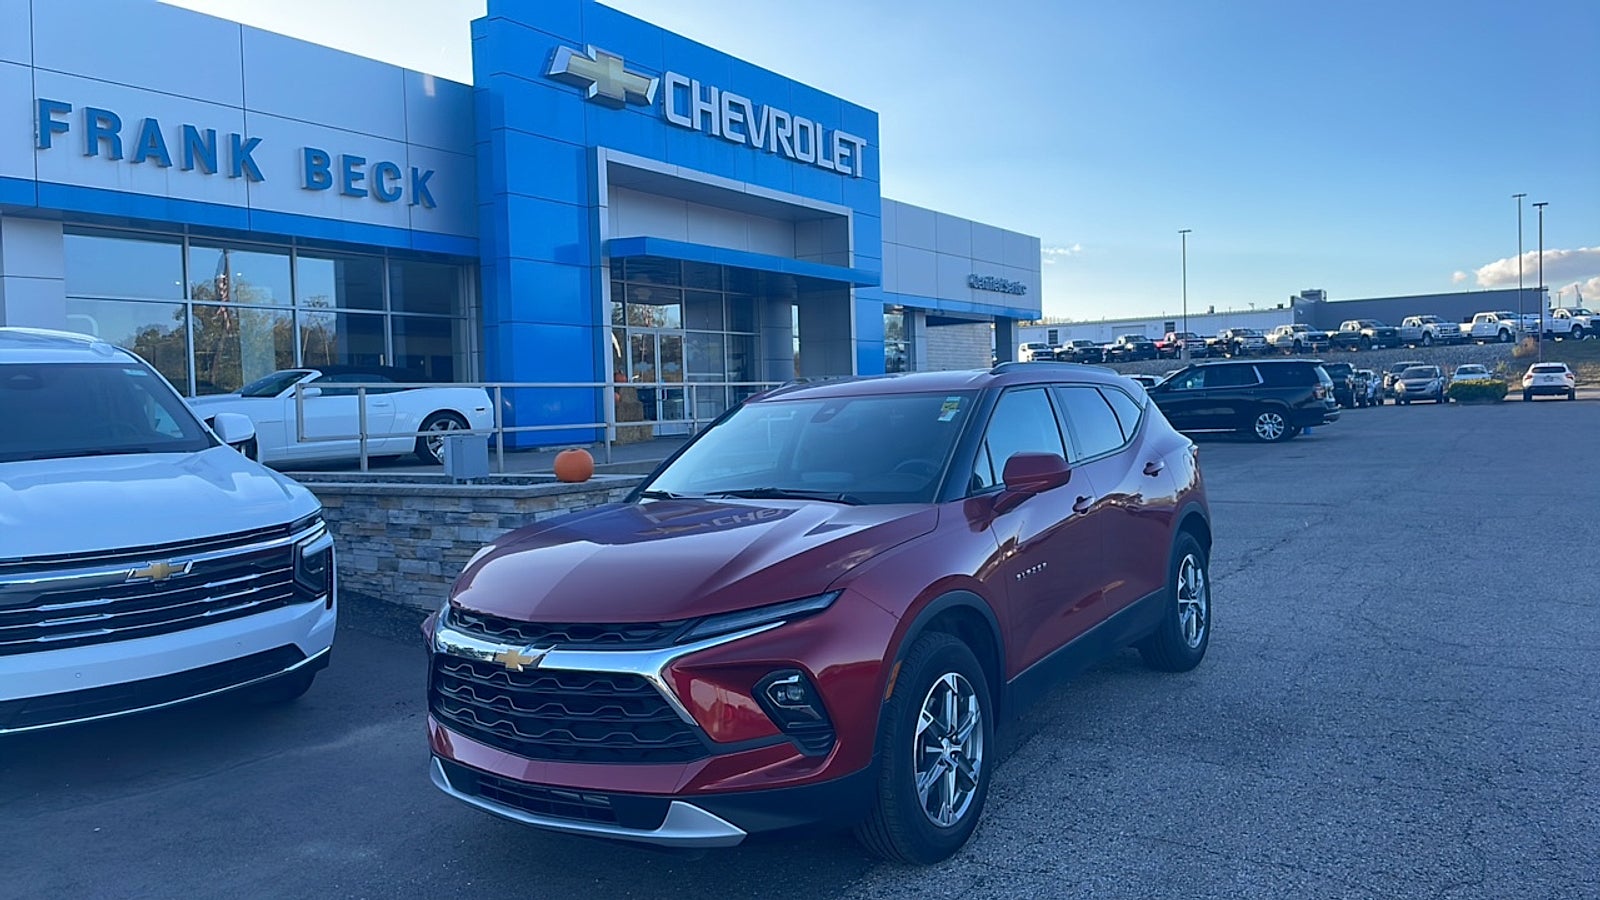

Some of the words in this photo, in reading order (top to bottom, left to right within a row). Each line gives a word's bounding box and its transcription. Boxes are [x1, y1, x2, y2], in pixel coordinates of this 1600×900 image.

[36, 97, 265, 182] FRANK
[300, 146, 437, 208] BECK
[664, 70, 867, 178] CHEVROLET
